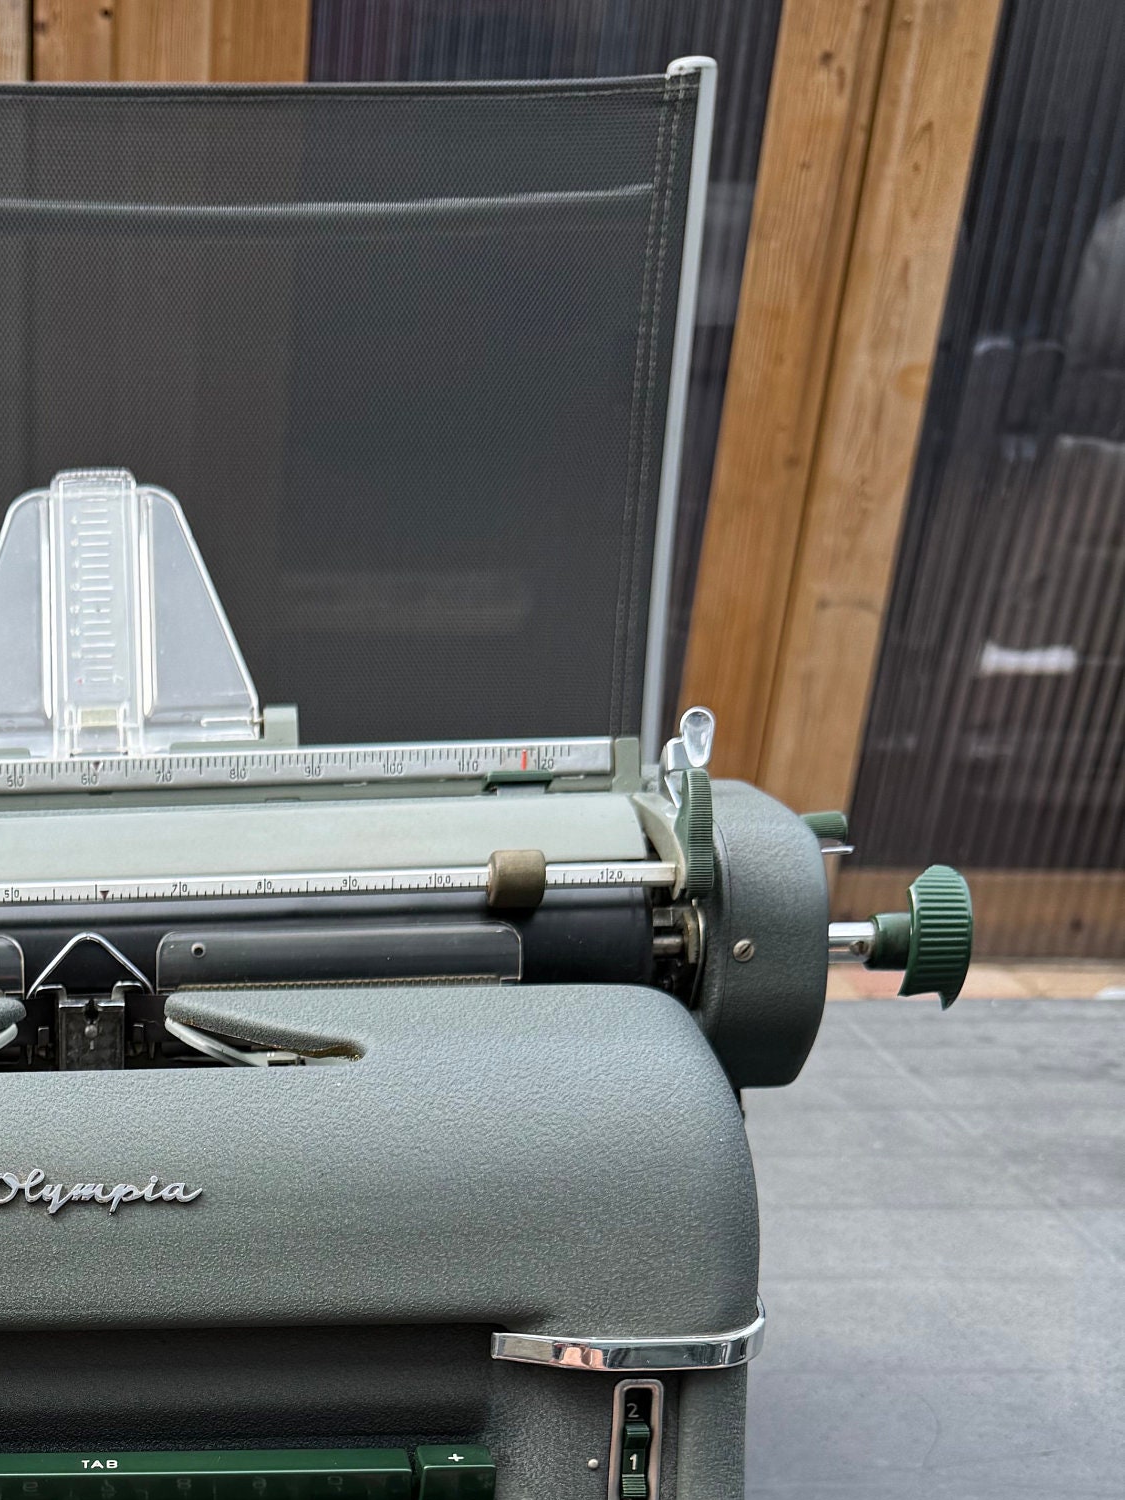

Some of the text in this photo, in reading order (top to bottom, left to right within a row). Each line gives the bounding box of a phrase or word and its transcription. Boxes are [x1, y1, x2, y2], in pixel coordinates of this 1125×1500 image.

[4, 889, 20, 900] 50
[171, 882, 188, 895] 70
[256, 879, 272, 891] 80
[342, 877, 358, 889] 90
[428, 874, 452, 886] 100
[600, 868, 624, 881] 120
[626, 1402, 640, 1418] 2
[81, 1459, 118, 1469] TAB
[629, 1453, 638, 1471] 1
